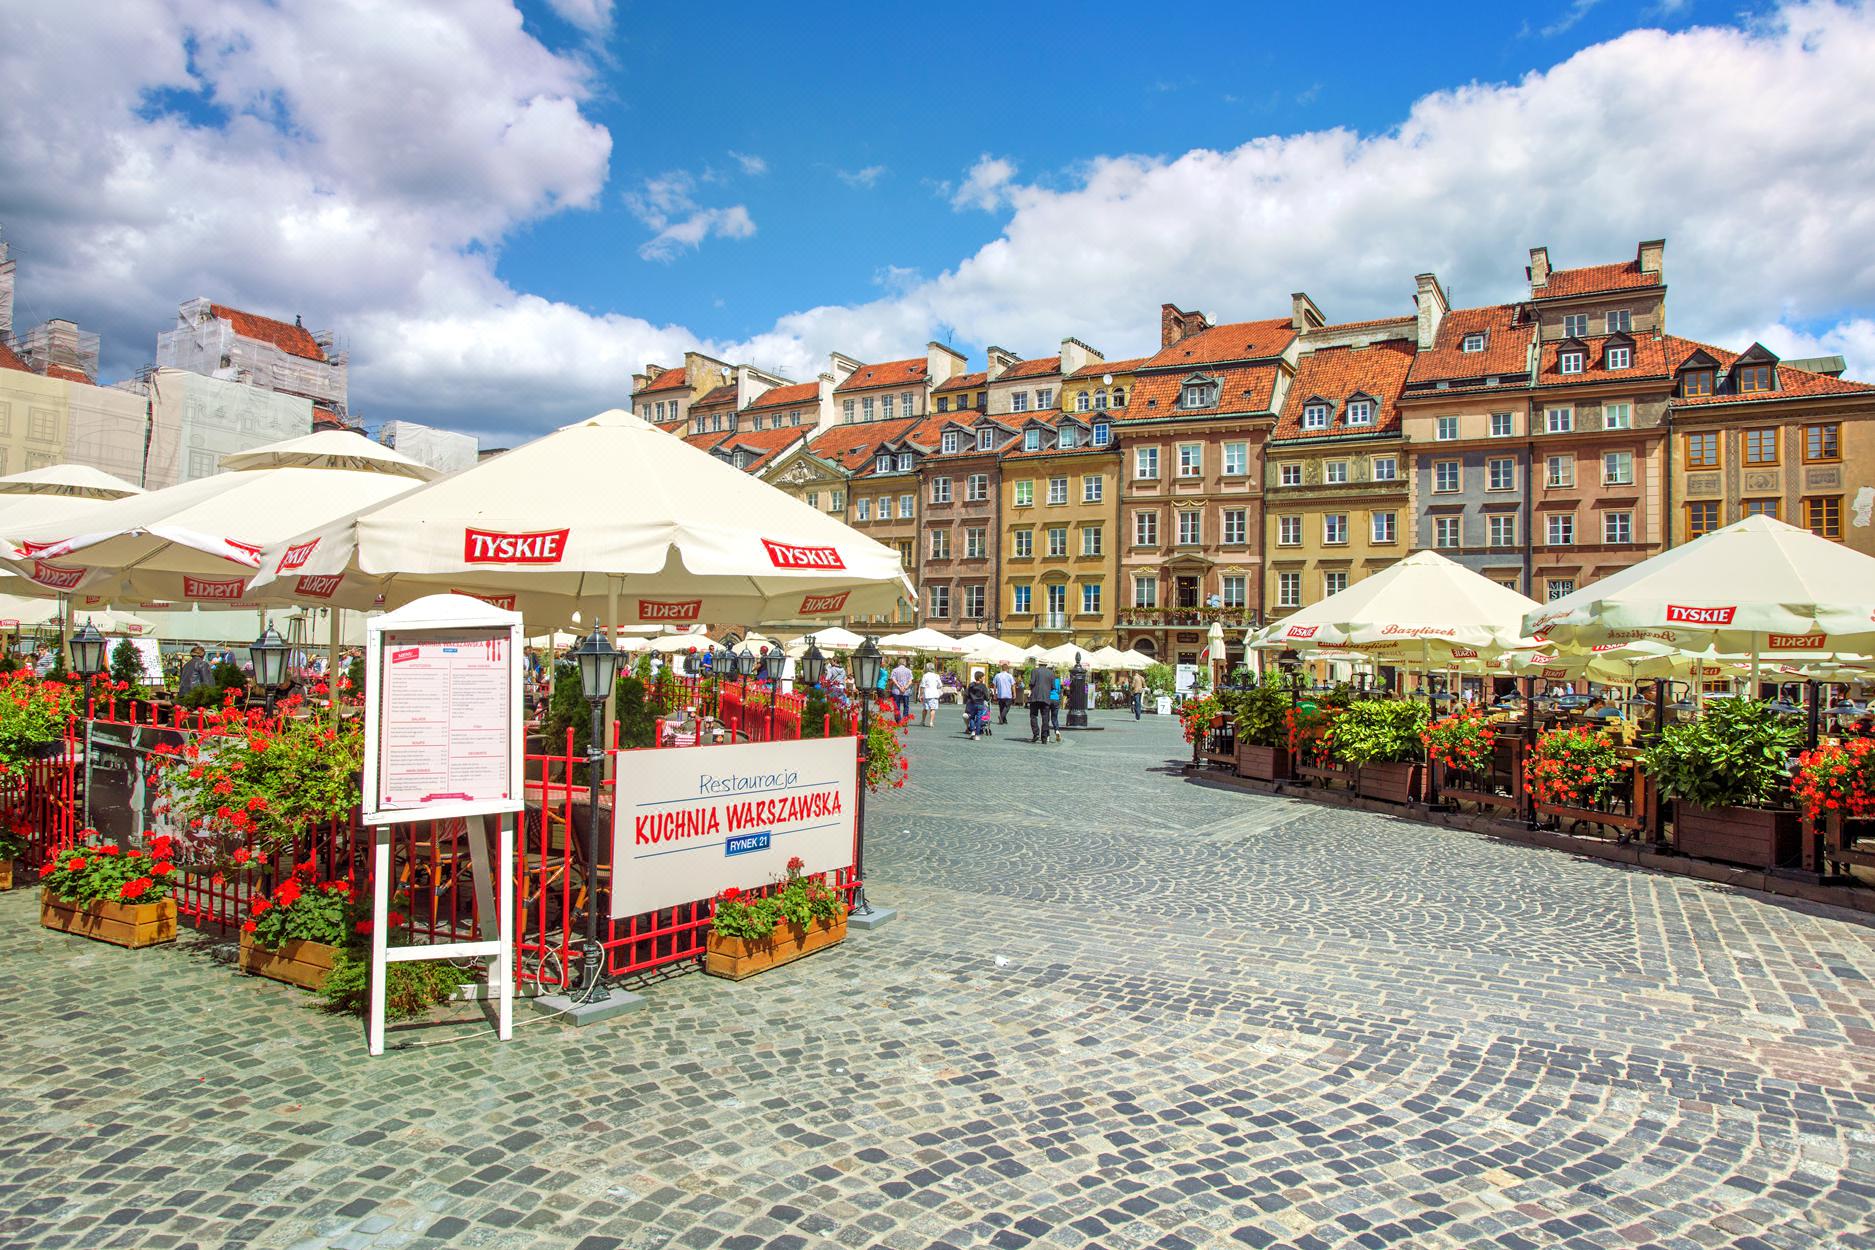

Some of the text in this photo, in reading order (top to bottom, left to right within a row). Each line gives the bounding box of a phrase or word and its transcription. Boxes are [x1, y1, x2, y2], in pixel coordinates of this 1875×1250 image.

[471, 534, 560, 559] TYSKIE
[769, 543, 841, 567] TYSKIE
[1671, 607, 1730, 622] TYSKIE
[1289, 627, 1316, 638] TYSKIE
[699, 768, 798, 795] Restauracja
[634, 790, 842, 845] KUCHNIA WARSZAWSKA
[730, 836, 768, 851] RYNEK 21
